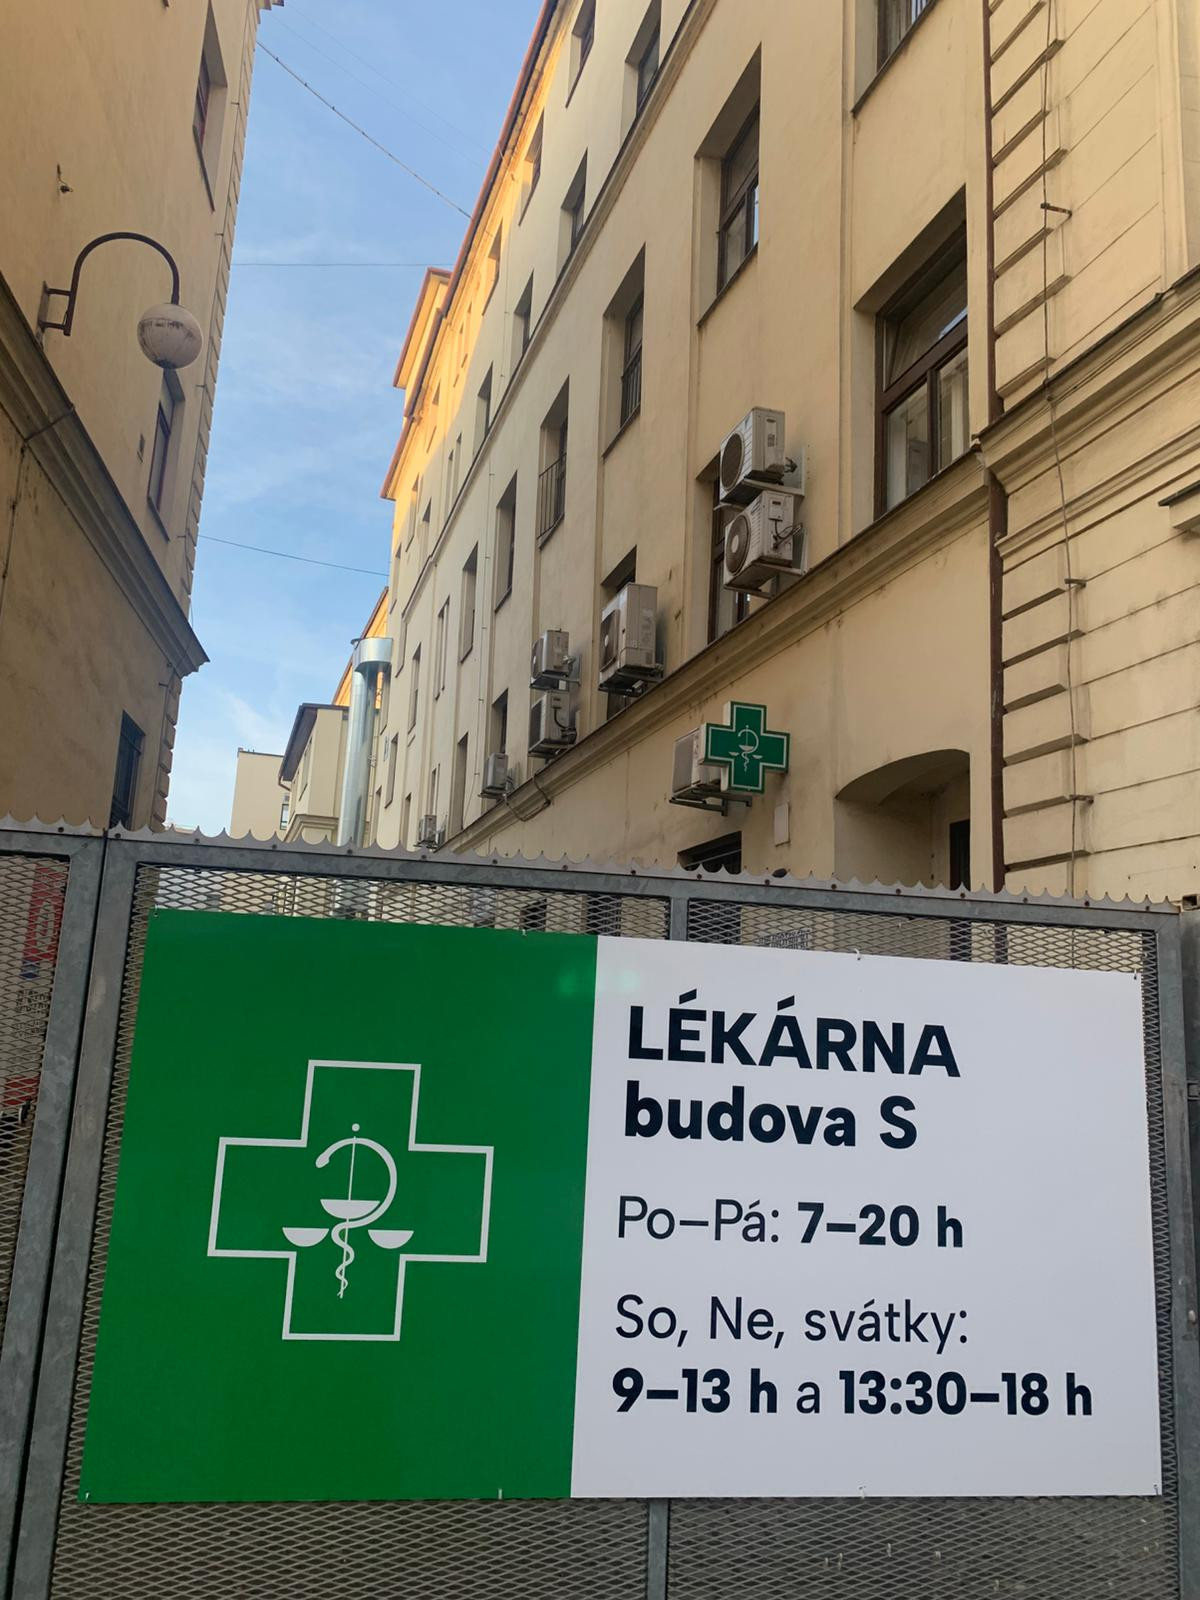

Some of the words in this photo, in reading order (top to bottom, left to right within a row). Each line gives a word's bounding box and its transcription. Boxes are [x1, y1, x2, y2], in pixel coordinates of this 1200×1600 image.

[628, 988, 961, 1078] LÉKÁRNA
[624, 1079, 856, 1147] budova
[879, 1095, 918, 1150] S
[618, 1195, 779, 1243] Po–Pá:
[797, 1201, 920, 1247] 7–20
[937, 1205, 963, 1248] h
[615, 1293, 688, 1348] So,
[709, 1295, 785, 1349] Ne,
[804, 1298, 968, 1355] svátky:
[612, 1366, 731, 1414] 9–13
[749, 1367, 778, 1414] h
[796, 1381, 821, 1414] a
[838, 1370, 1050, 1416] 13:30–18
[1065, 1372, 1093, 1416] h
